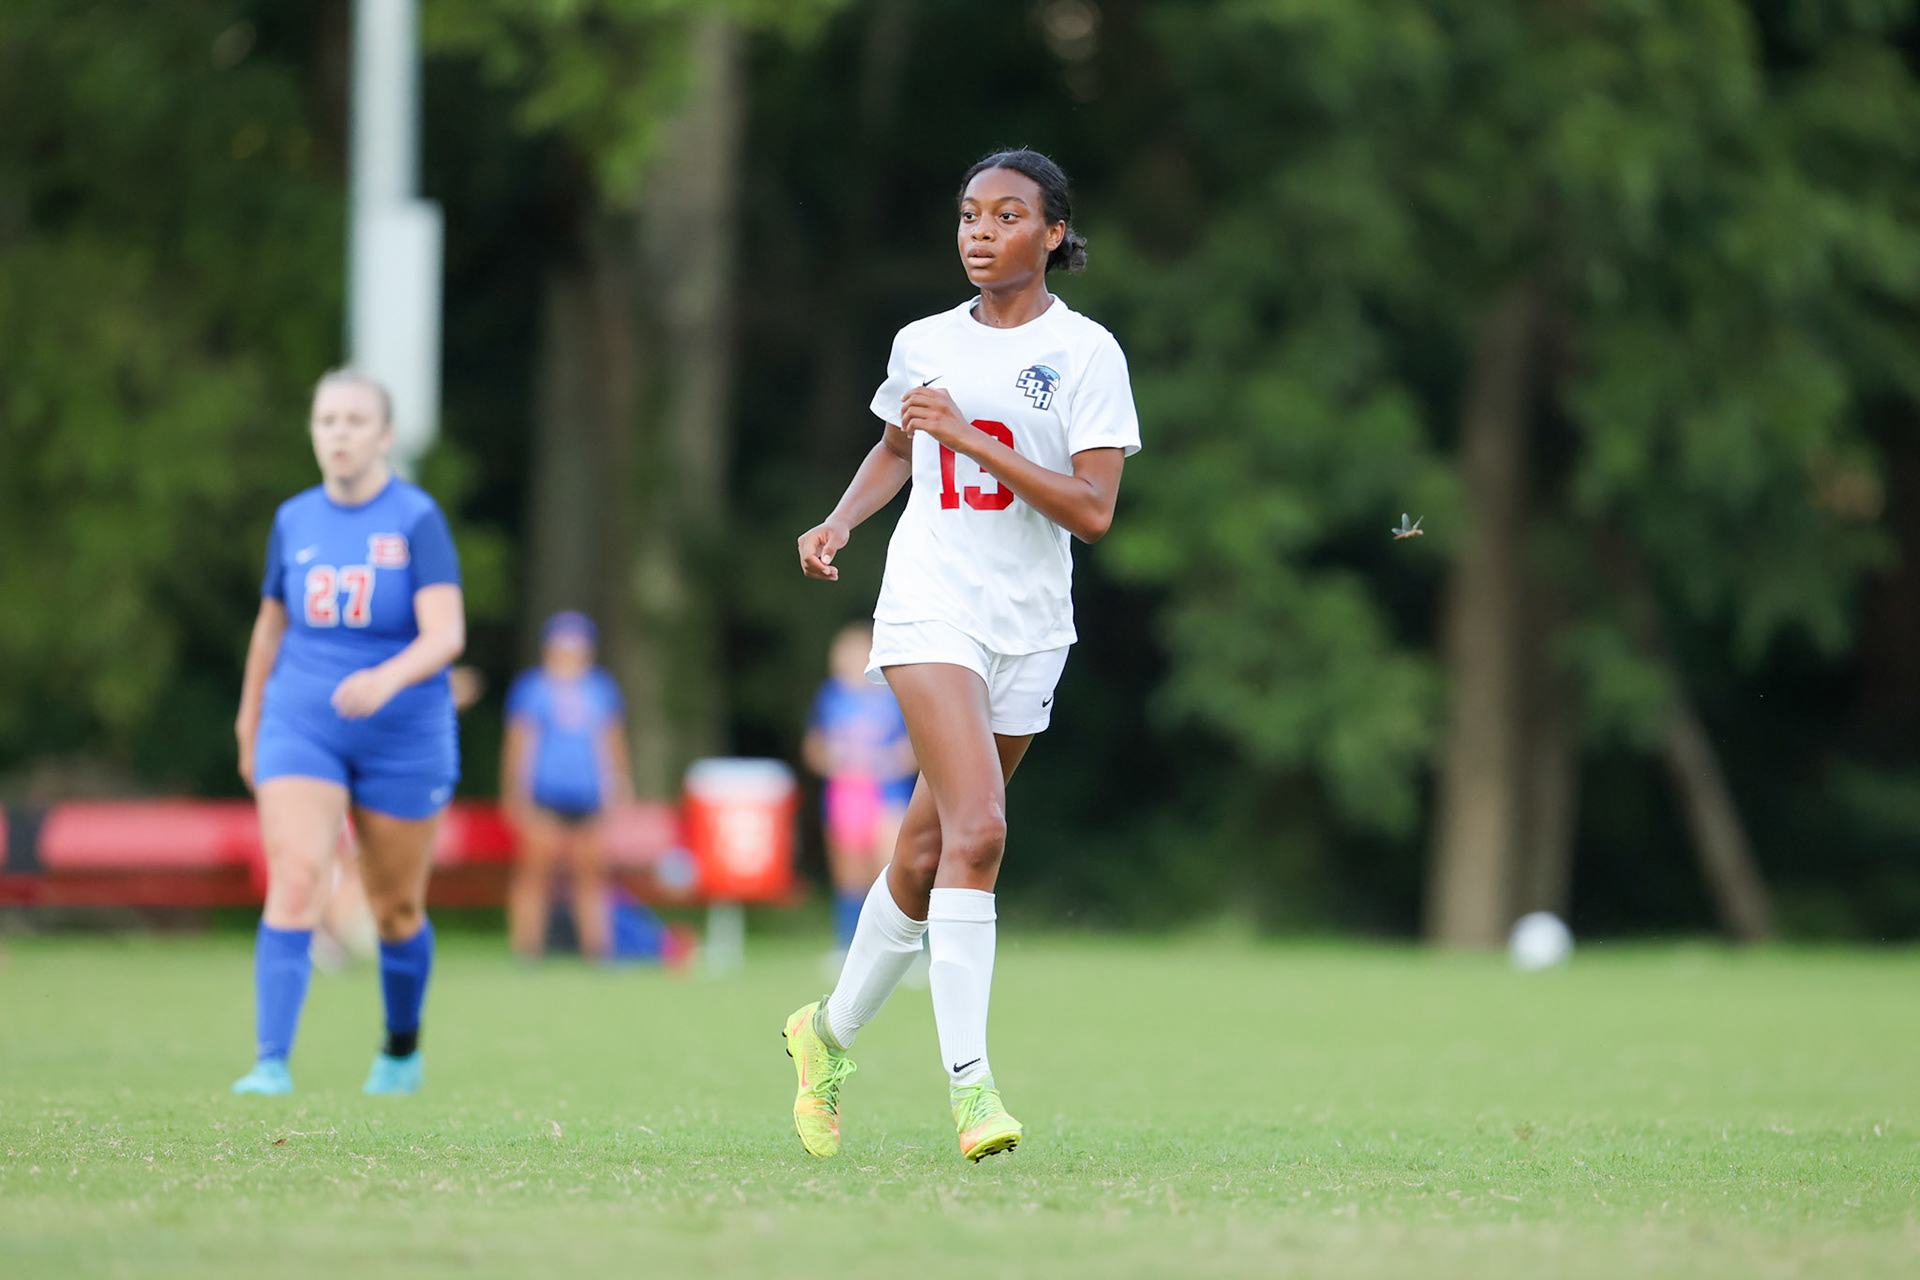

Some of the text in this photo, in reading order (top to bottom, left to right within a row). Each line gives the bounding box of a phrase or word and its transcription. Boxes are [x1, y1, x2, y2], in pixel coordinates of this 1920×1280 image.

[1016, 369, 1053, 410] SBA
[939, 419, 1014, 510] 13
[305, 566, 374, 627] 27
